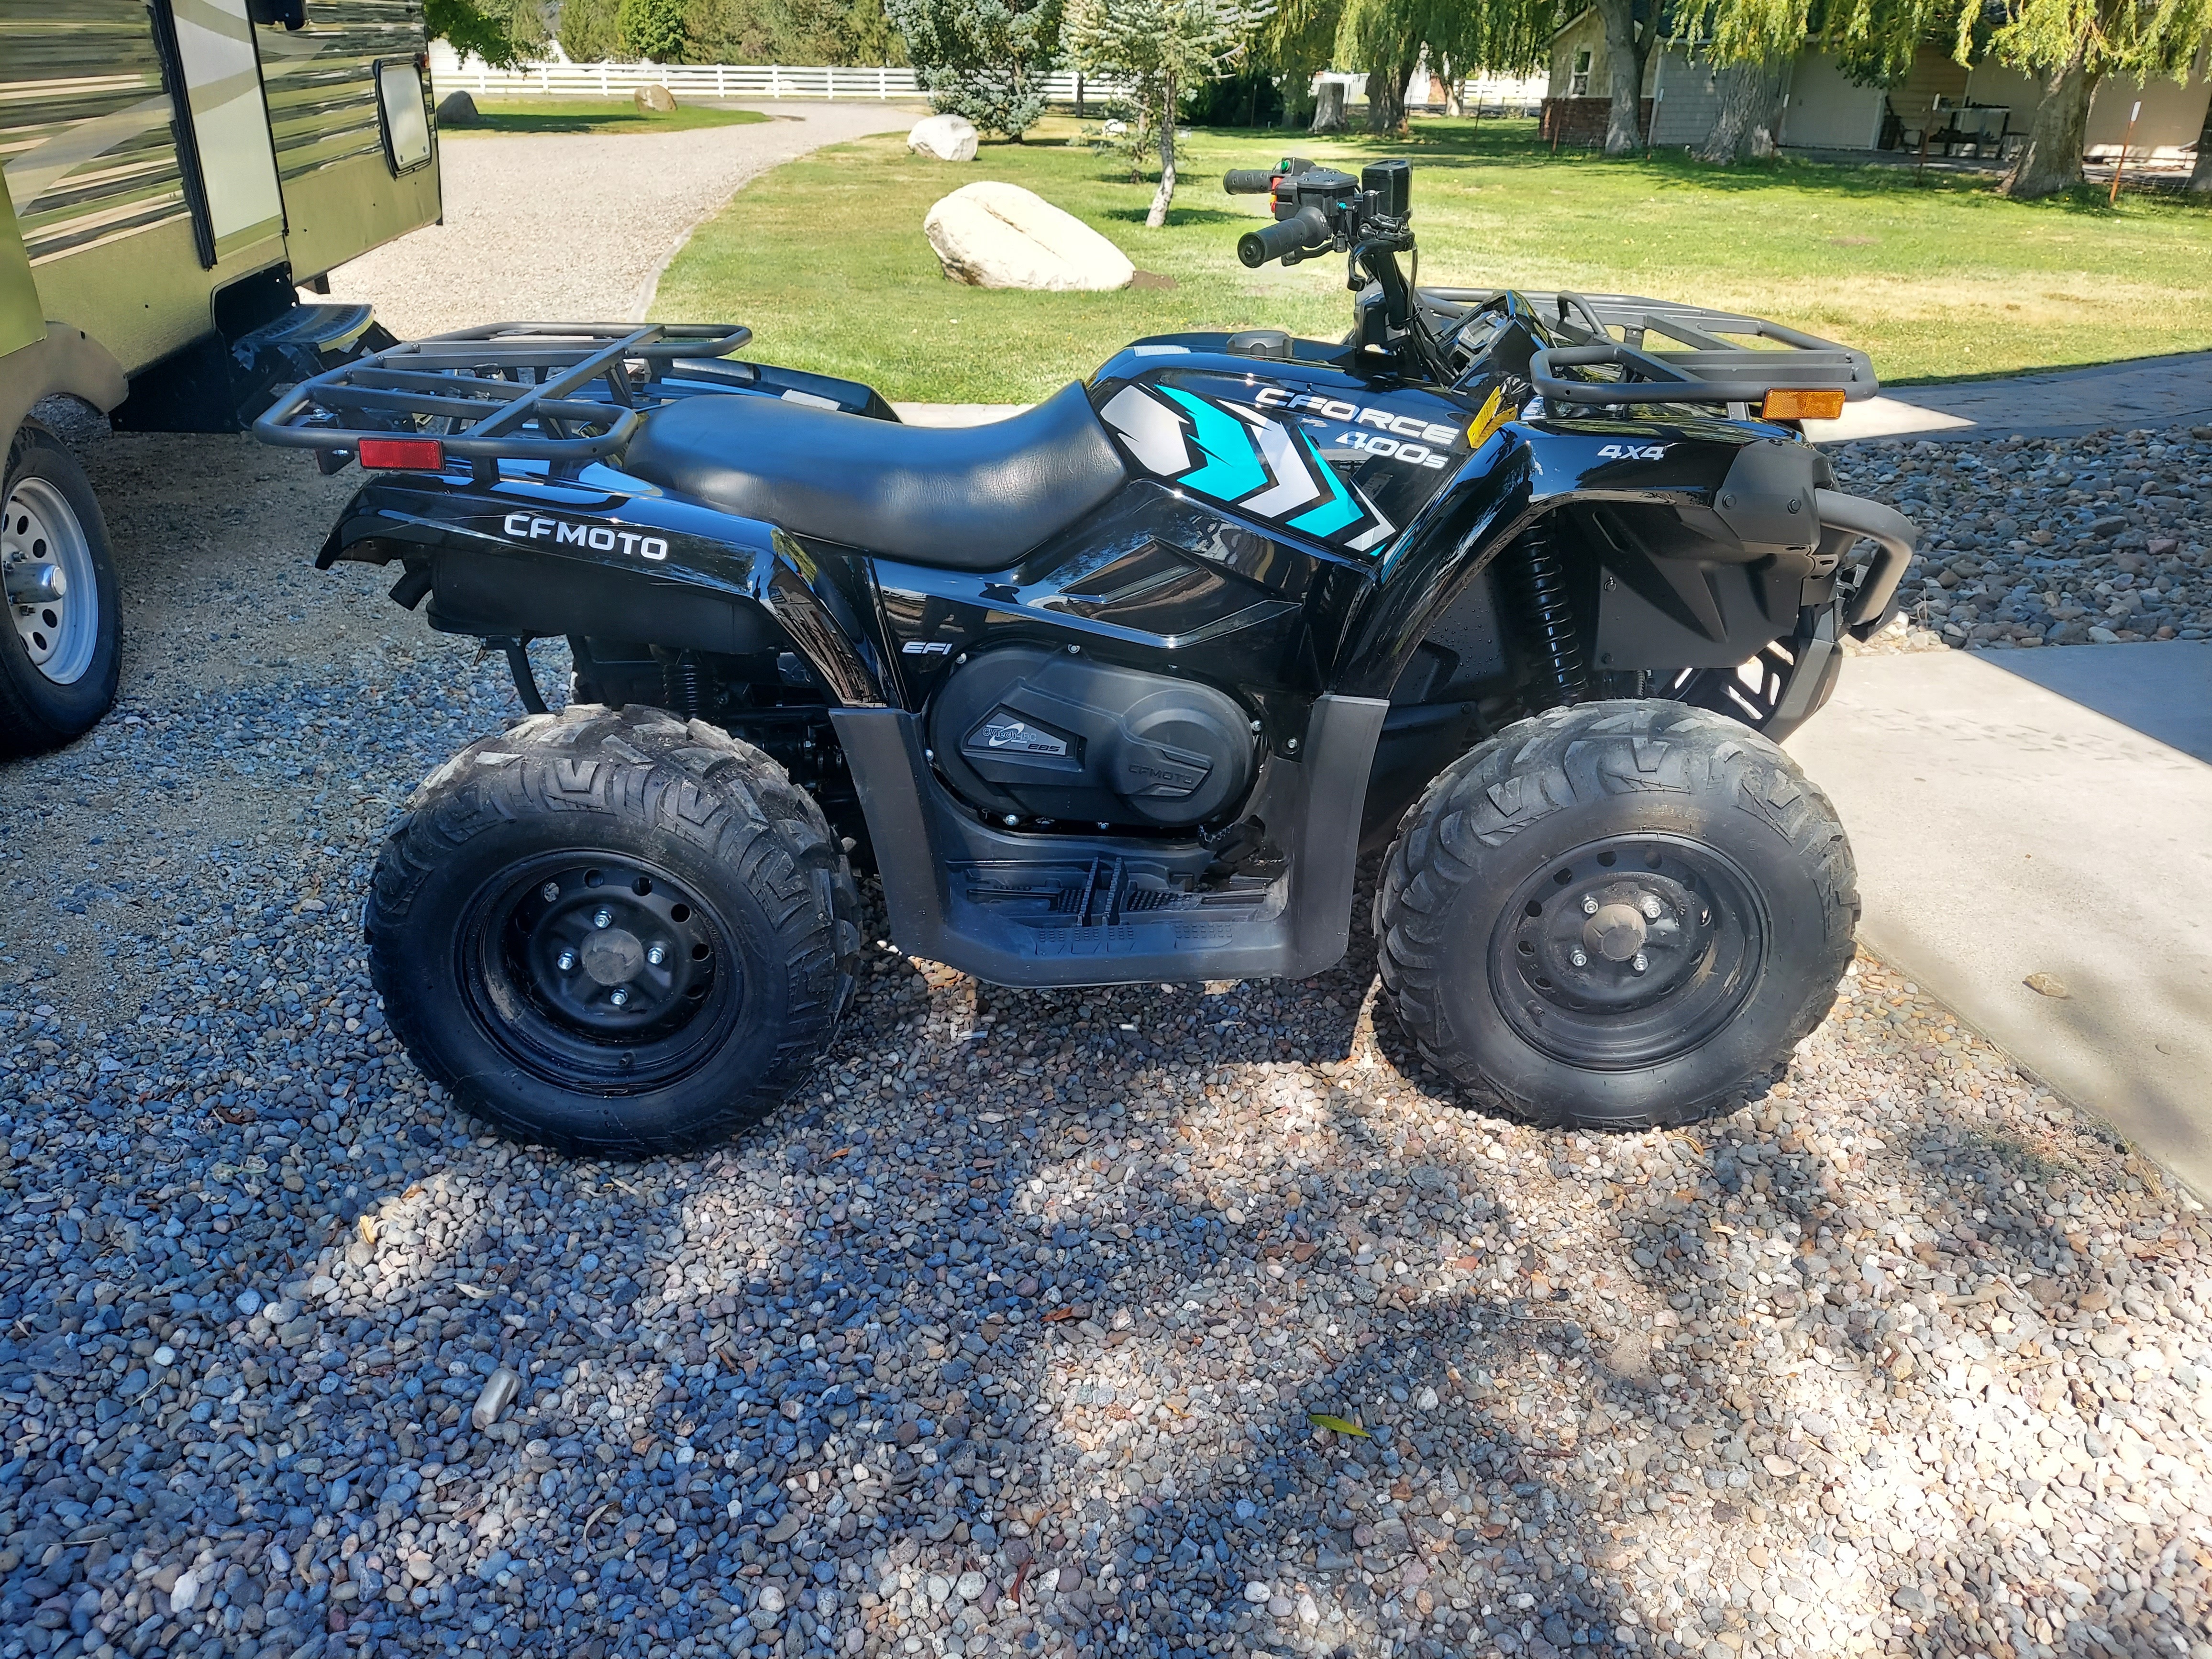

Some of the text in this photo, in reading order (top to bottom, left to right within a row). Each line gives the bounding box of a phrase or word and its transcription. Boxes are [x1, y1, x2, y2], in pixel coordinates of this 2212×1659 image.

[1254, 387, 1460, 445] CFORCE
[1597, 444, 1666, 460] 4X4
[504, 514, 668, 560] CFMOTO
[902, 641, 953, 655] EFI
[1028, 743, 1061, 752] EBS
[1128, 764, 1193, 785] CFMOTO
